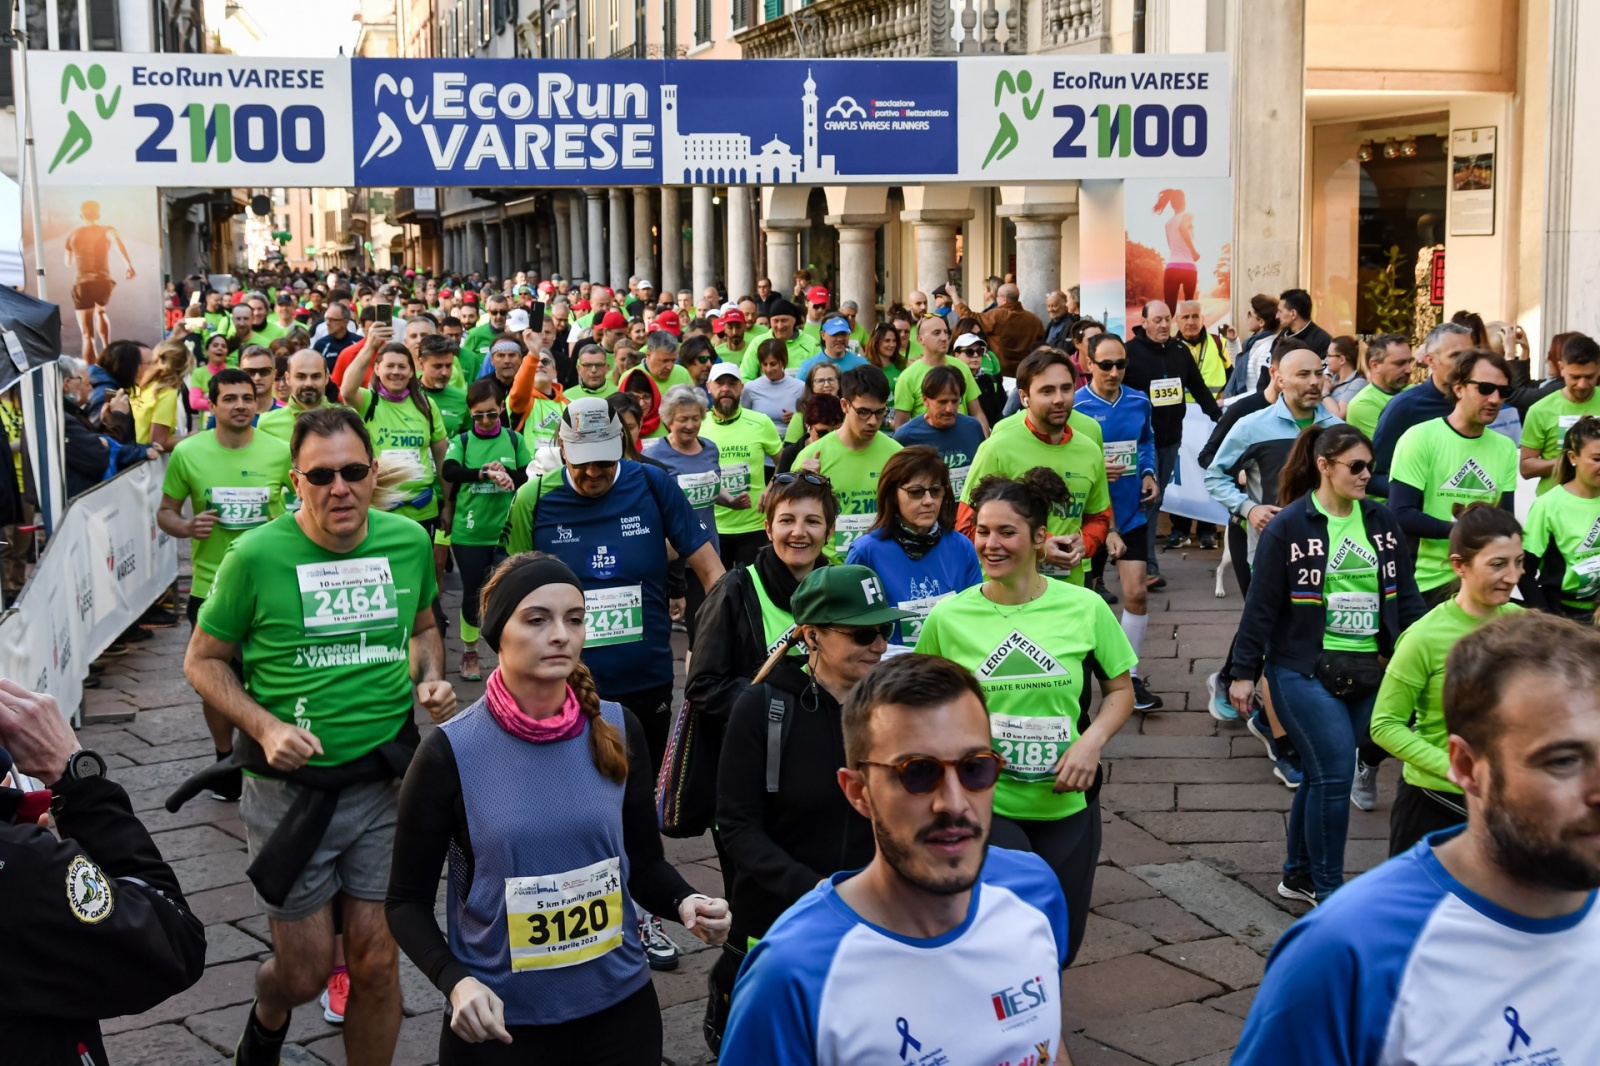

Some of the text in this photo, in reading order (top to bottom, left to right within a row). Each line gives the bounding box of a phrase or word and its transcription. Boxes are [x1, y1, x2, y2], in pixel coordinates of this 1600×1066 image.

[132, 66, 324, 89] EcoRun VARESE
[1053, 72, 1209, 90] EcoRun VARESE
[433, 72, 648, 120] EcoRun
[824, 121, 930, 130] CAMPUS VARESE RUNNERS
[421, 123, 655, 170] VARESE
[1154, 387, 1179, 399] 3354
[1113, 454, 1132, 466] 40
[1449, 458, 1494, 489] LEROY MERLIN
[687, 484, 716, 501] 2137
[221, 503, 262, 519] 2375
[621, 515, 641, 524] team
[621, 522, 641, 530] novo
[622, 527, 651, 537] nordisk
[1583, 524, 1599, 548] LEROY
[1330, 537, 1378, 570] LEROY MERLIN
[1297, 568, 1322, 586] 20
[314, 585, 388, 617] 2464
[600, 602, 617, 610] Family
[584, 608, 633, 632] 2421
[1330, 611, 1374, 629] 2200
[309, 643, 358, 656] EcoRun
[980, 632, 1055, 676] LEROY MERLIN
[307, 652, 361, 667] VARESE
[982, 679, 1072, 693] OLBIATE RUNNING TEAM
[293, 697, 308, 717] 5
[998, 741, 1058, 766] 2183
[537, 900, 544, 909] 5
[561, 893, 585, 905] Family
[586, 889, 602, 898] Run
[527, 899, 609, 945] 3120
[558, 941, 580, 951] aprile
[581, 935, 598, 945] 2023
